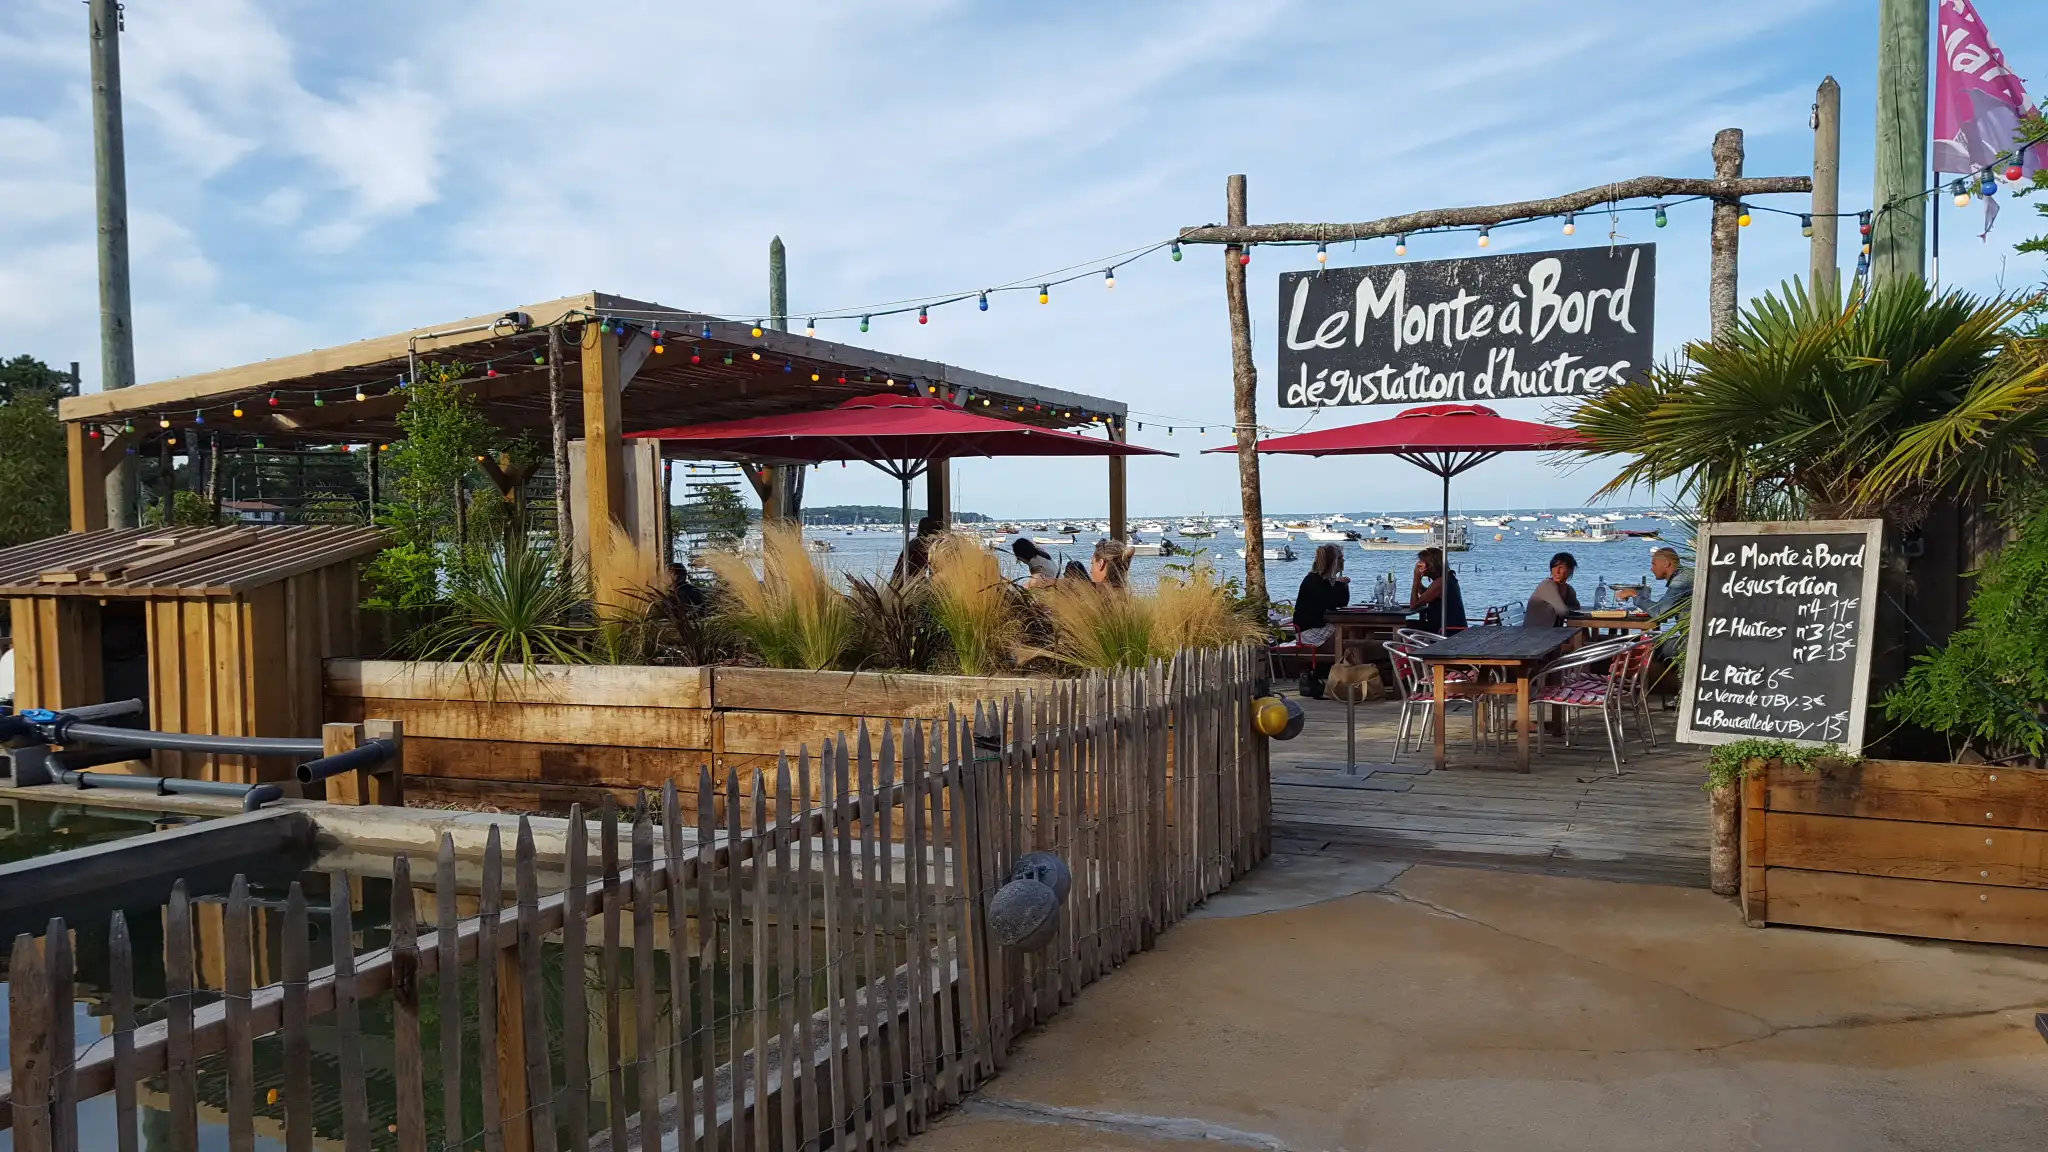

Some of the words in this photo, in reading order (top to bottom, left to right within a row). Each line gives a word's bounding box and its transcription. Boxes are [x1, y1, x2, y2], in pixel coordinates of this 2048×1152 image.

[1286, 277, 1349, 351] Le
[1355, 269, 1494, 352] Monte
[1498, 283, 1527, 335] à
[1528, 248, 1641, 344] Bord
[1287, 362, 1465, 406] dégustation
[1711, 543, 1736, 566] Le
[1741, 542, 1800, 569] Monte
[1801, 548, 1814, 568] à
[1815, 543, 1866, 569] Bord
[1721, 570, 1839, 598] dégustation
[1708, 617, 1730, 637] 12
[1701, 664, 1720, 682] Le
[1724, 665, 1765, 686] Pâté
[1698, 687, 1712, 701] Le
[1714, 688, 1745, 704] Verre
[1745, 690, 1758, 707] de
[1696, 708, 1711, 726] La
[1760, 714, 1774, 732] de
